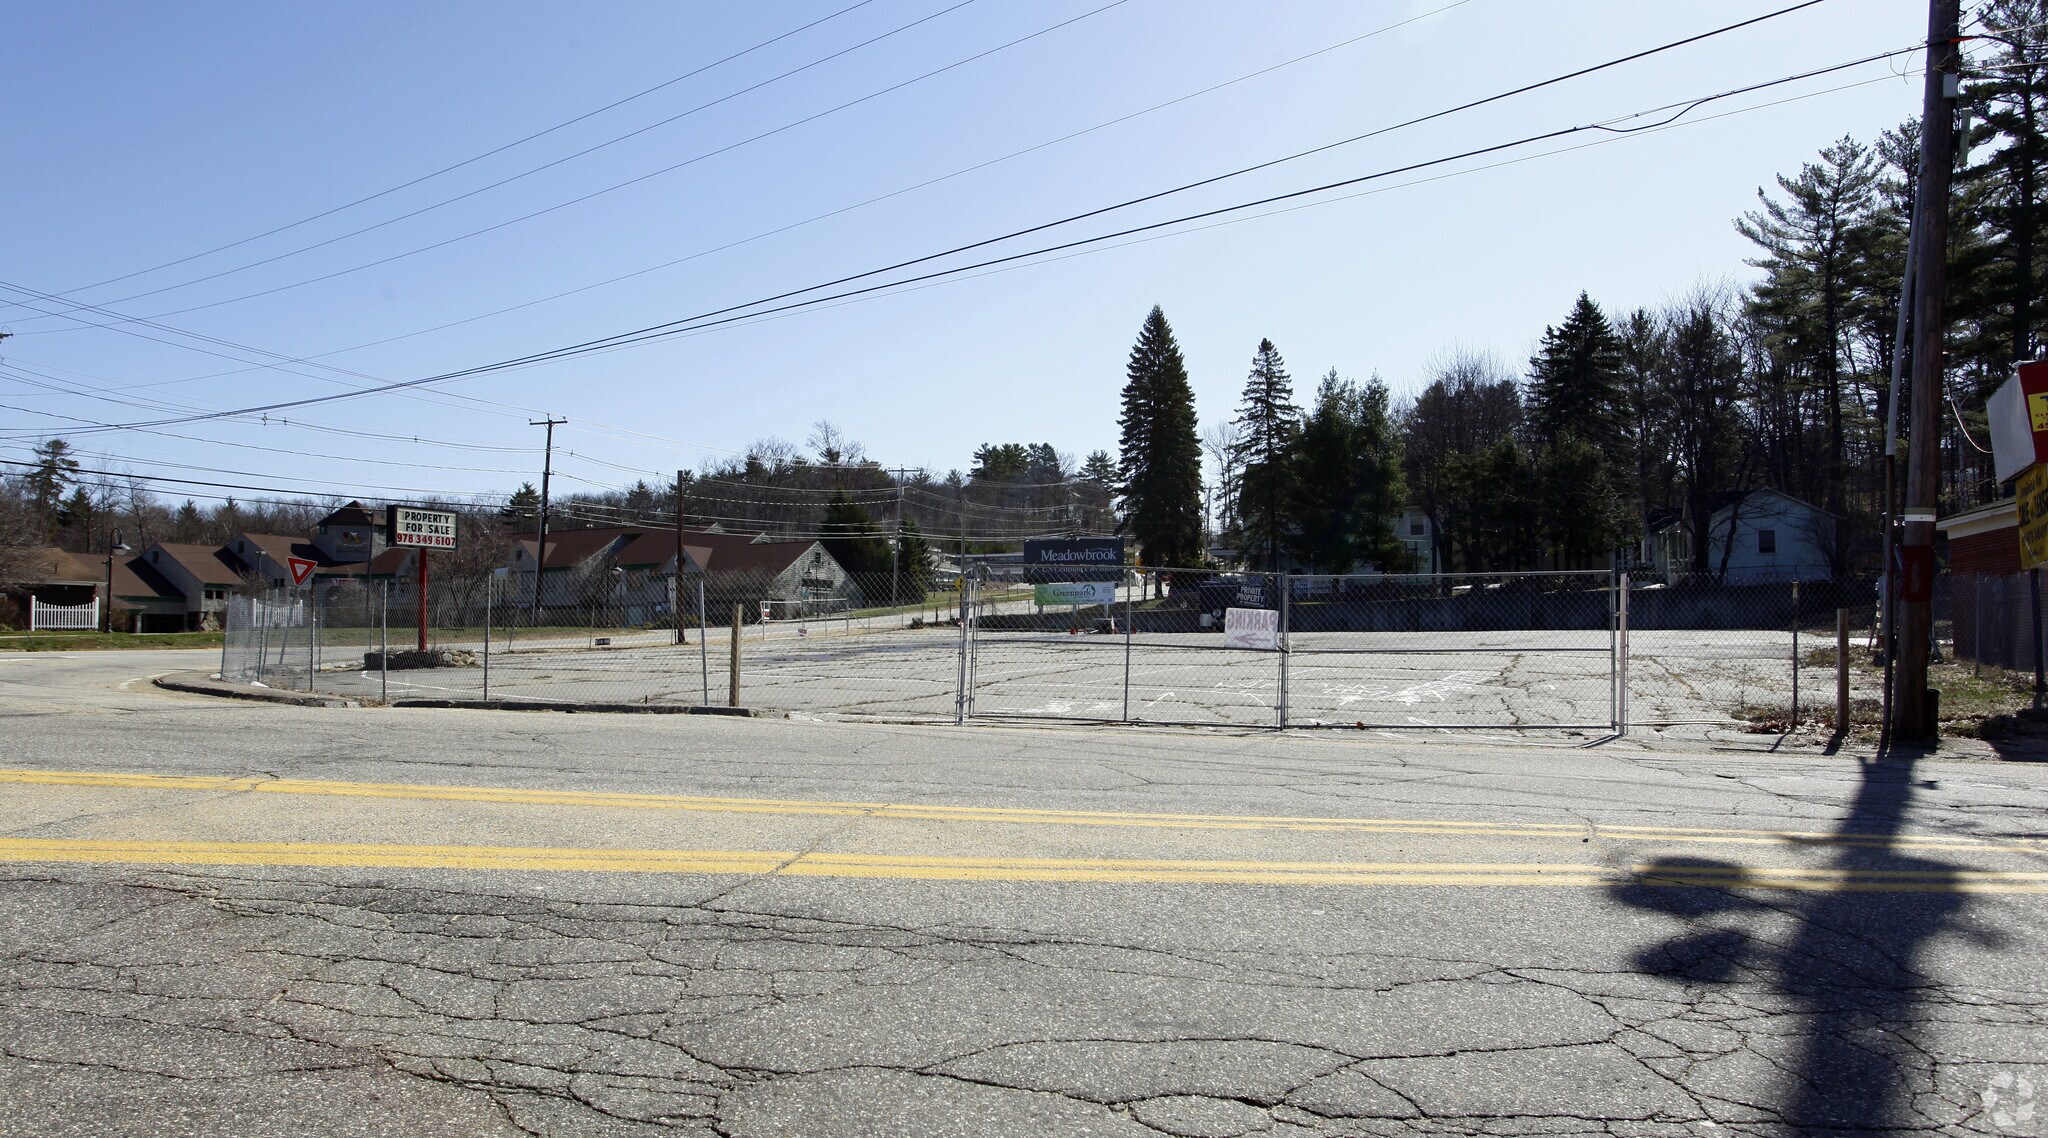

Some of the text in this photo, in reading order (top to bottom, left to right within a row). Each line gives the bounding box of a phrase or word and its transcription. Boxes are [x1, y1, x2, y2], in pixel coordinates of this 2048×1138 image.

[405, 511, 450, 523] PROPERTY
[406, 523, 450, 535] FOR SALE
[397, 533, 456, 547] 978 349 6107
[1041, 548, 1117, 561] Meadowbrook
[1053, 588, 1092, 599] Greenpark
[1240, 586, 1262, 595] PRIVATE
[1236, 593, 1265, 603] PROPERTY
